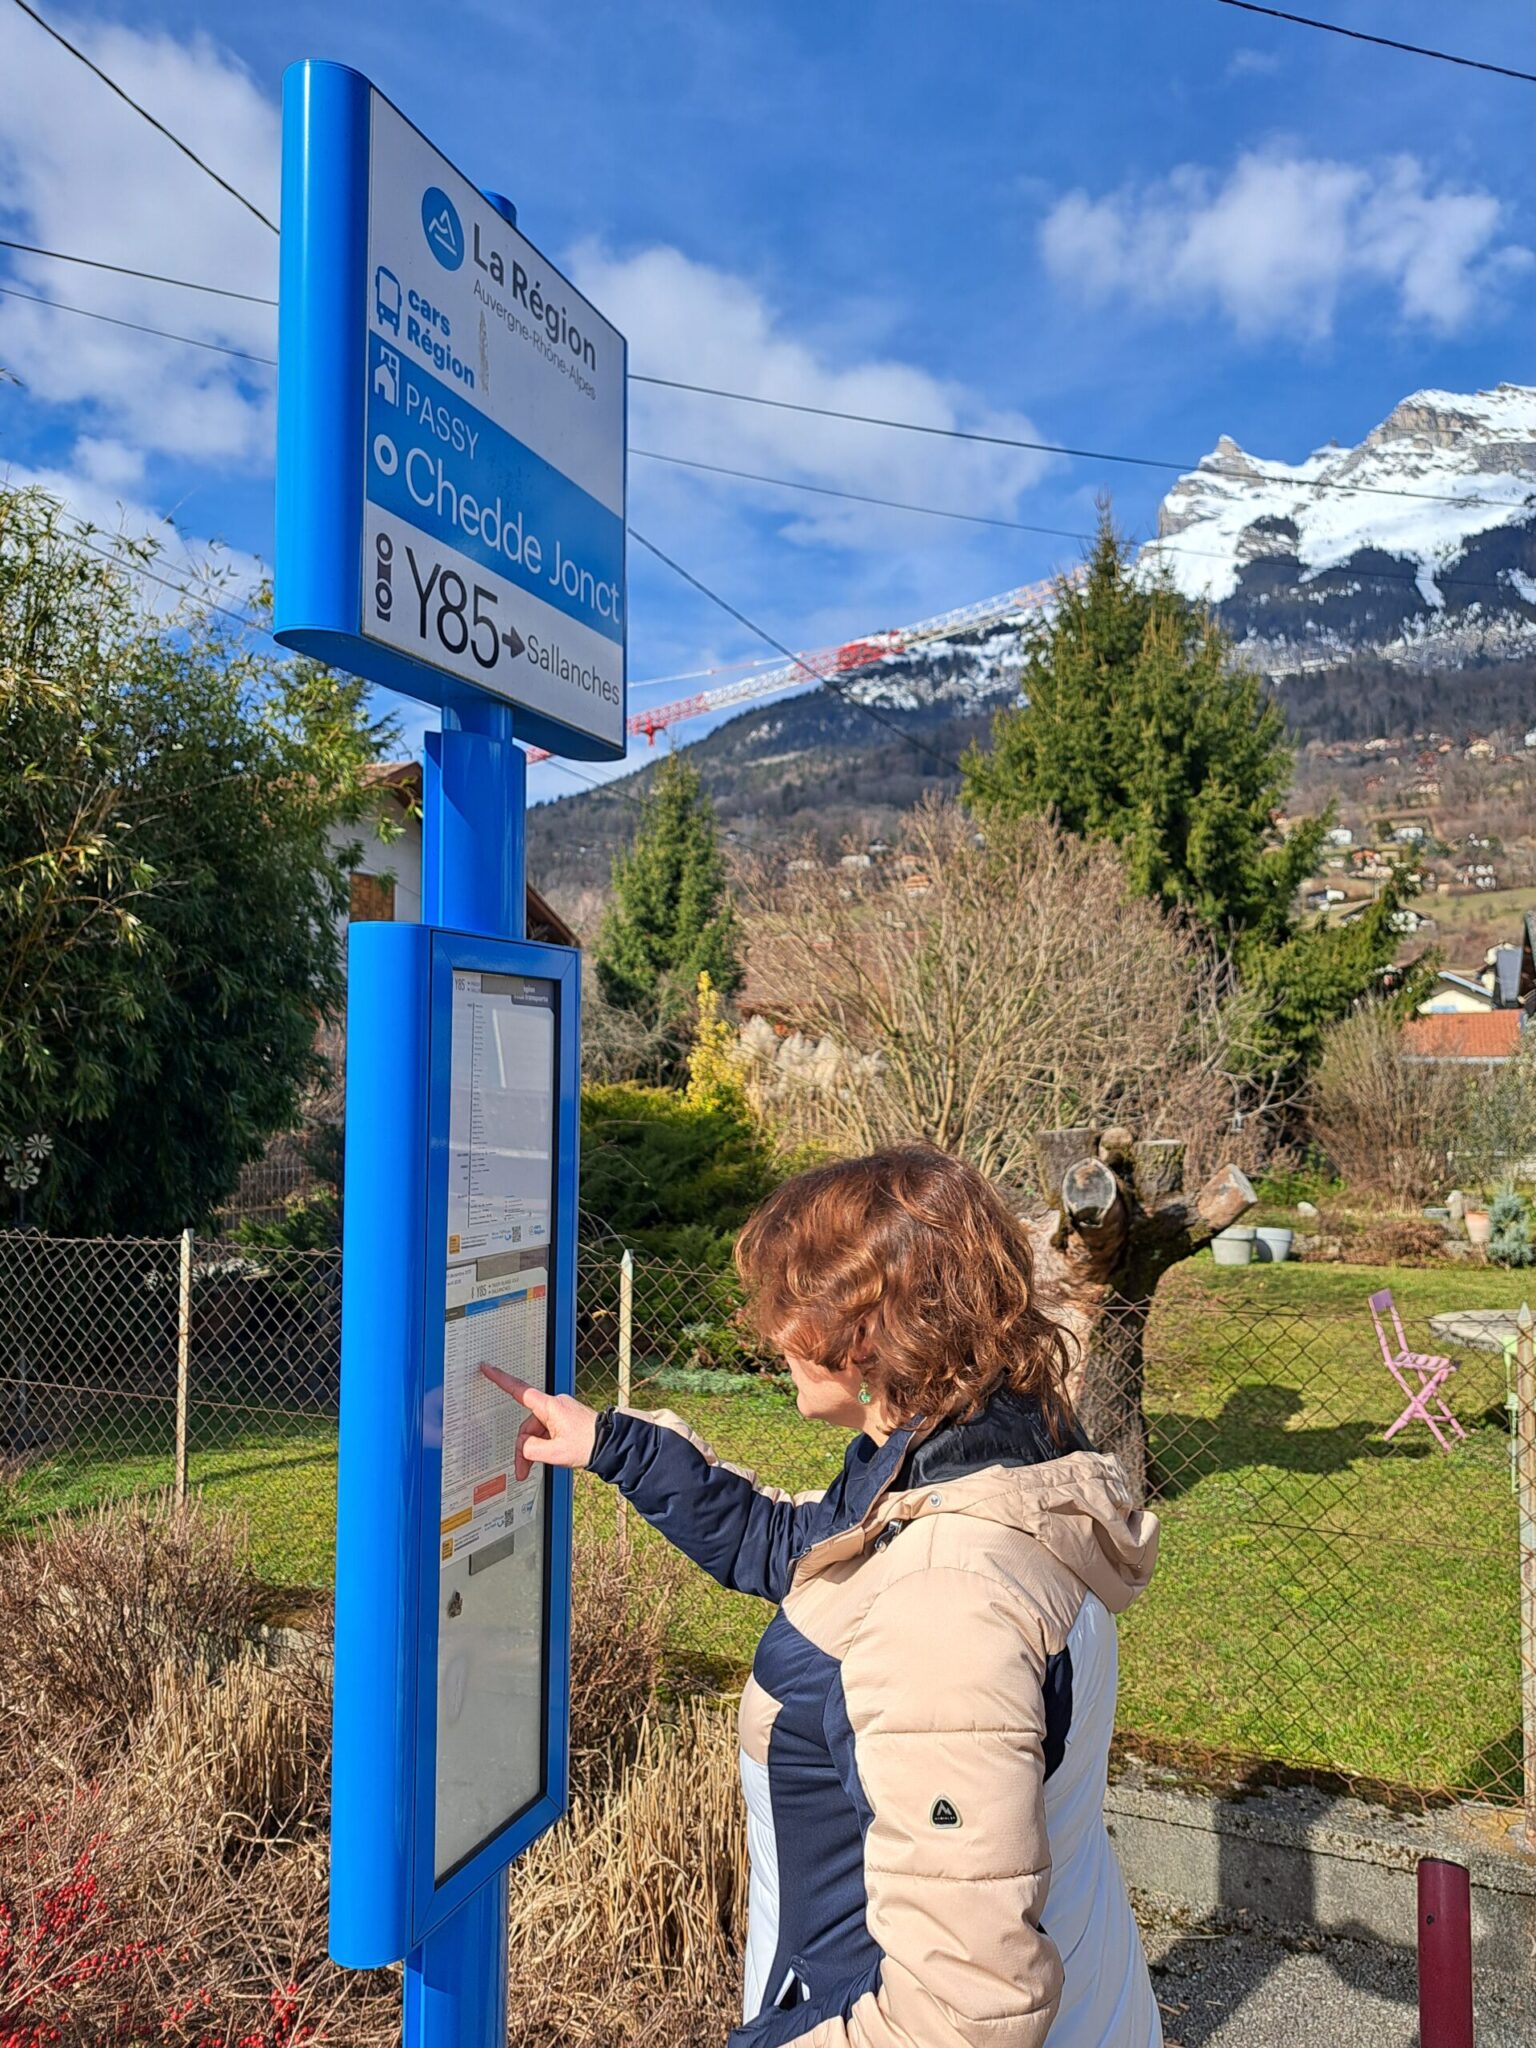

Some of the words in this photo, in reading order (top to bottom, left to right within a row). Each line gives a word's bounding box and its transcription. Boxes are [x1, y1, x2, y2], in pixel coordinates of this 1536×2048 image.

[407, 314, 475, 390] Région
[408, 288, 451, 337] cars
[473, 279, 597, 400] Auvergne-Rhône-Alpes
[474, 222, 504, 286] La
[513, 260, 597, 372] Région
[406, 382, 479, 460] PASSY
[405, 448, 542, 575] Chedde
[549, 540, 621, 625] Jonct
[405, 545, 500, 670] Y85
[527, 635, 620, 706] Sallanches
